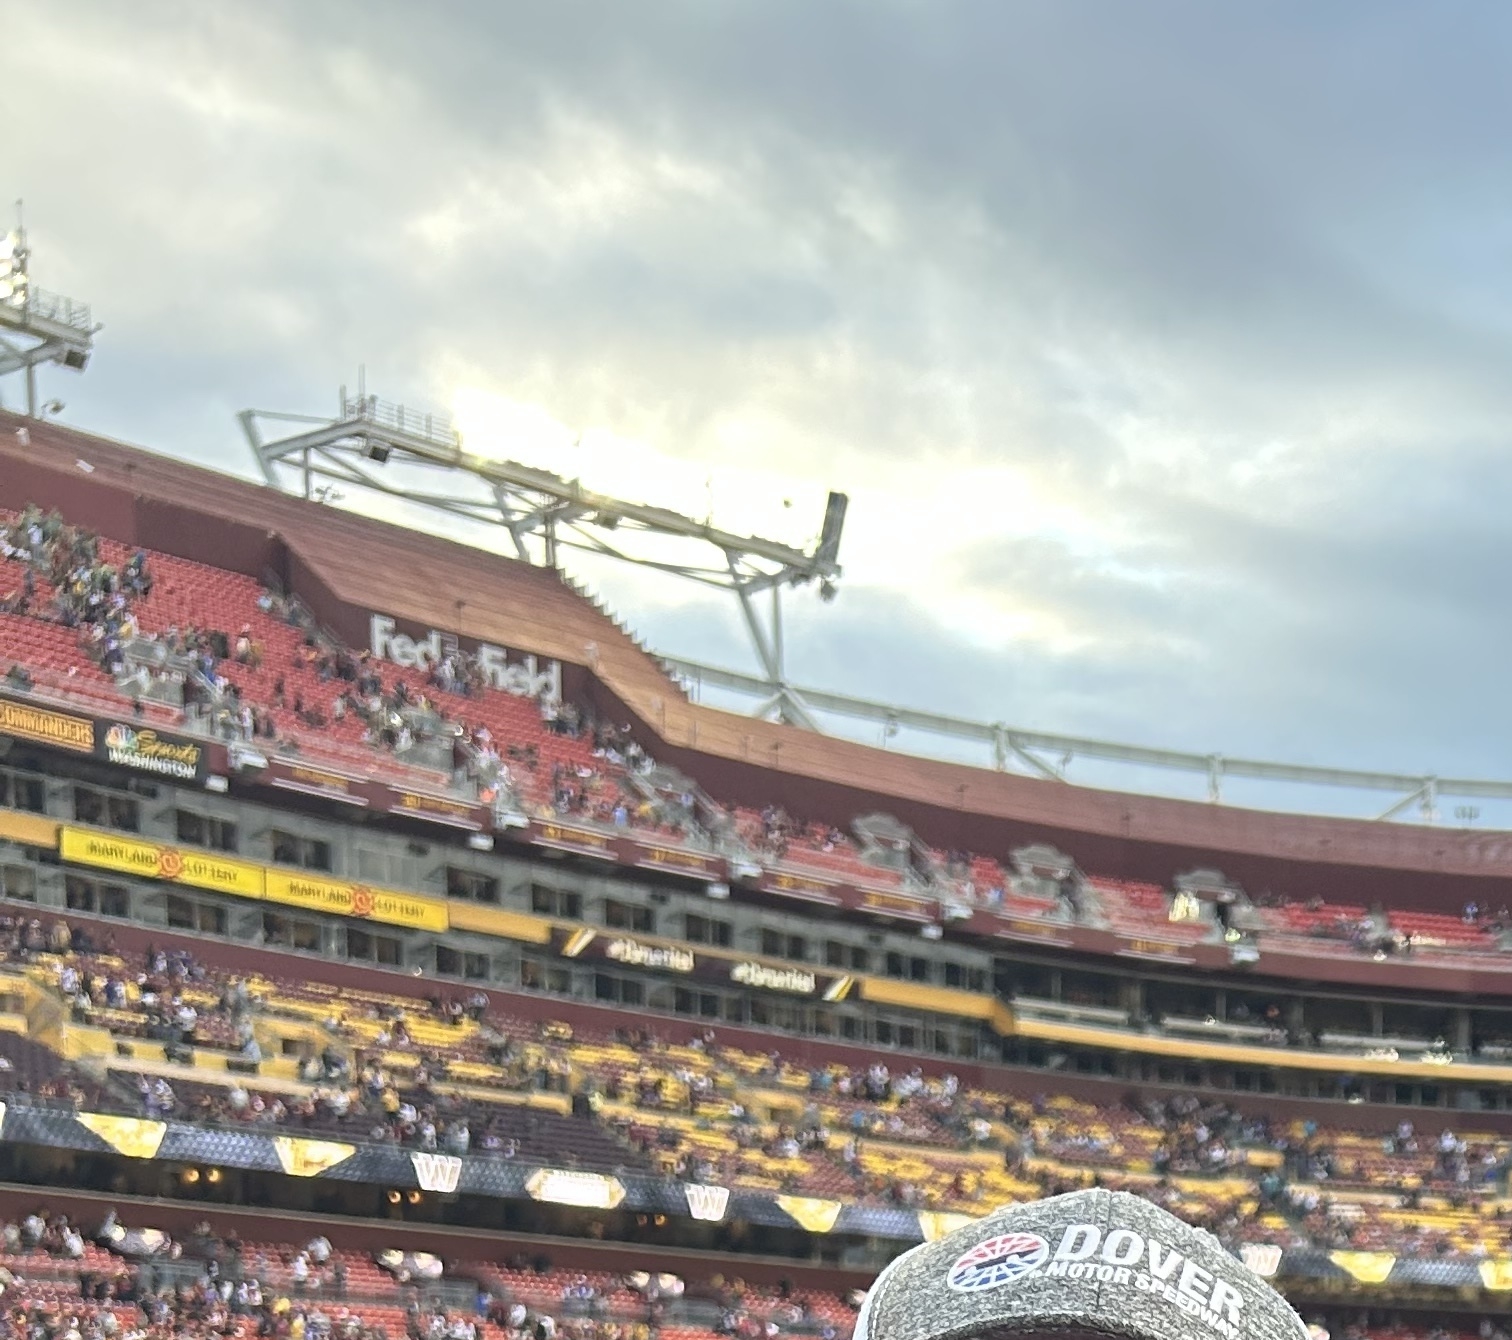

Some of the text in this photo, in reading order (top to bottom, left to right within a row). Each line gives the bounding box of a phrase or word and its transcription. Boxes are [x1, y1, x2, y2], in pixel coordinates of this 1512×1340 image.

[108, 750, 198, 778] WASHINGTON
[1045, 1260, 1240, 1340] MOTOR SPEEDWAY
[1053, 1224, 1244, 1327] DOVER
